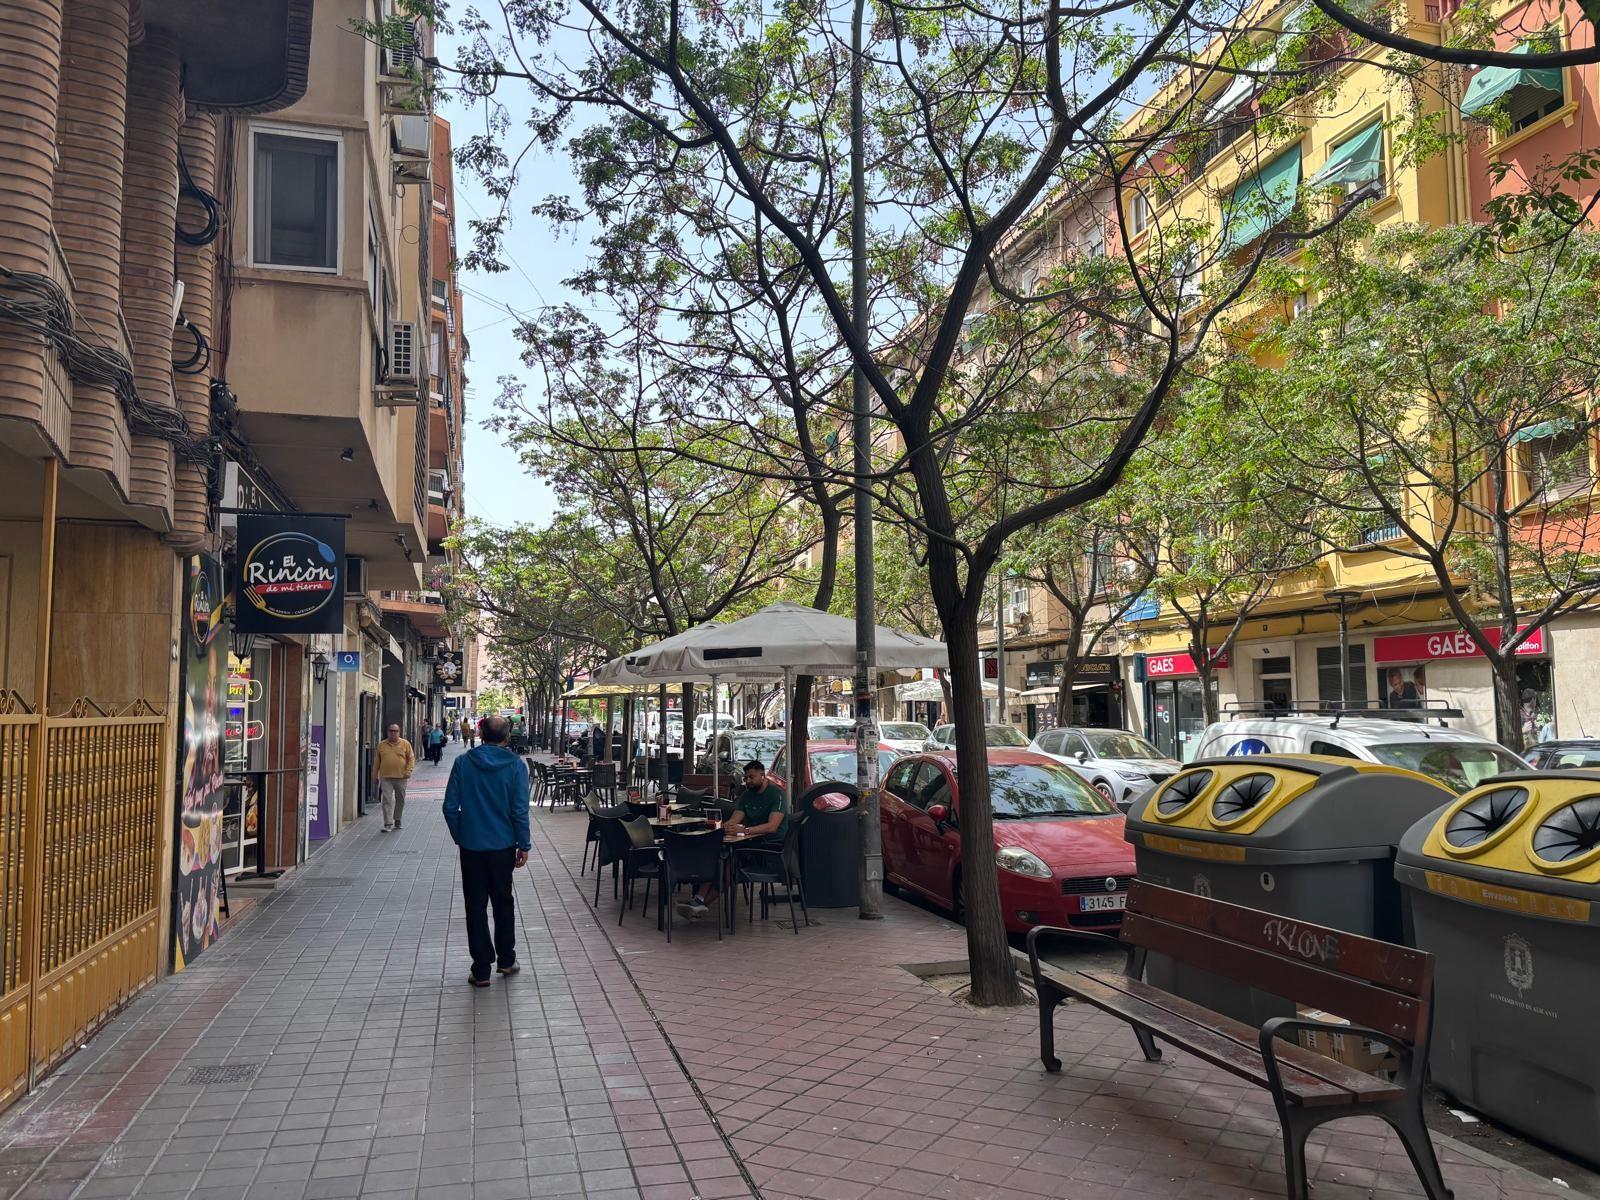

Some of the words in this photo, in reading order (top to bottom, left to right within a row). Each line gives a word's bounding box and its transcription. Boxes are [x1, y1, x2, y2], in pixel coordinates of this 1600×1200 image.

[283, 555, 296, 567] El
[266, 584, 278, 593] de
[281, 583, 294, 592] mi
[1427, 633, 1476, 656] GAES
[1149, 658, 1174, 674] GAES
[1089, 897, 1114, 909] 3145
[1481, 888, 1519, 904] Envases
